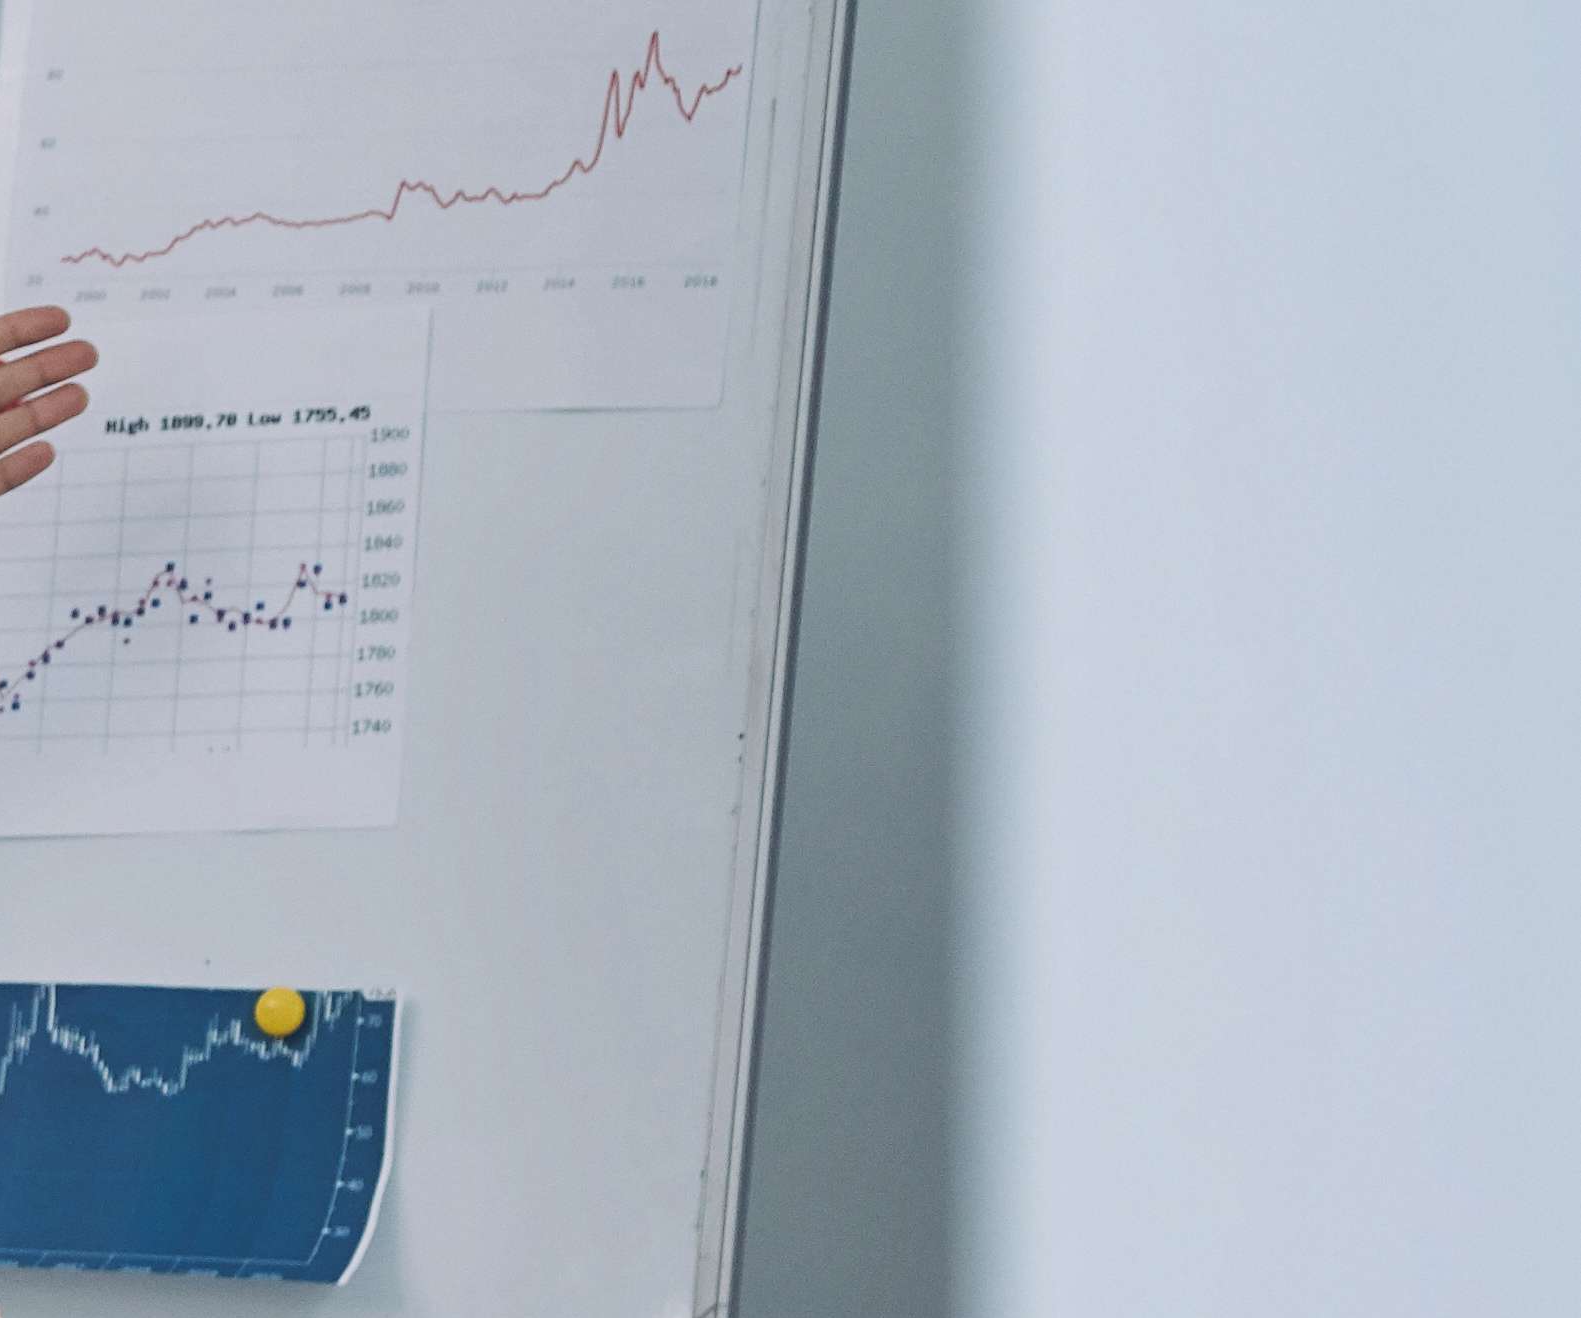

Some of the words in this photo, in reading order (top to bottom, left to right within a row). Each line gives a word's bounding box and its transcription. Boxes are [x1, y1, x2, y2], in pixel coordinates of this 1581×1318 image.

[106, 416, 149, 434] High
[248, 411, 281, 425] Low
[293, 406, 371, 423] 1755.45
[371, 426, 409, 442] 1900
[358, 645, 396, 661] 1780
[355, 682, 394, 698] 1760
[352, 720, 391, 735] 1740
